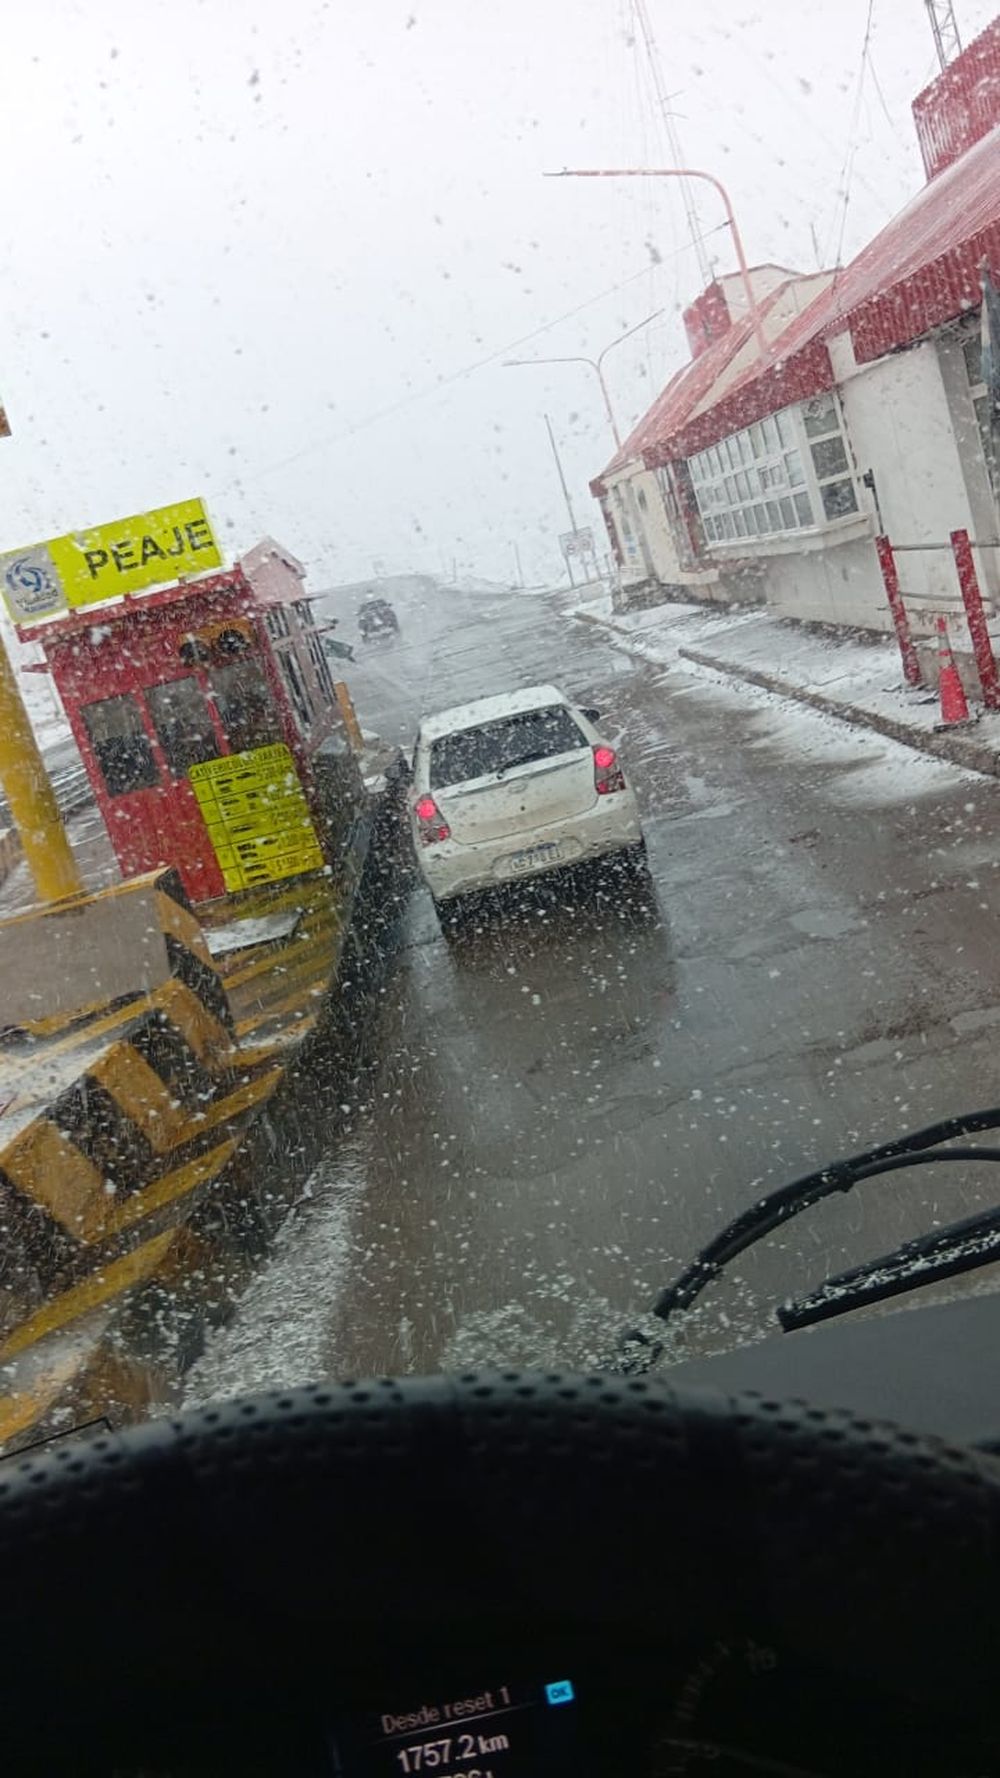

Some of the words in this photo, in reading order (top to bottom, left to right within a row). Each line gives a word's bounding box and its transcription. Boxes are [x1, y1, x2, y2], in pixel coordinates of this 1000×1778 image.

[84, 519, 213, 579] PEAJE
[382, 1707, 439, 1733] Desde
[444, 1692, 493, 1718] reset
[500, 1686, 511, 1704] 1
[551, 1687, 569, 1699] OK
